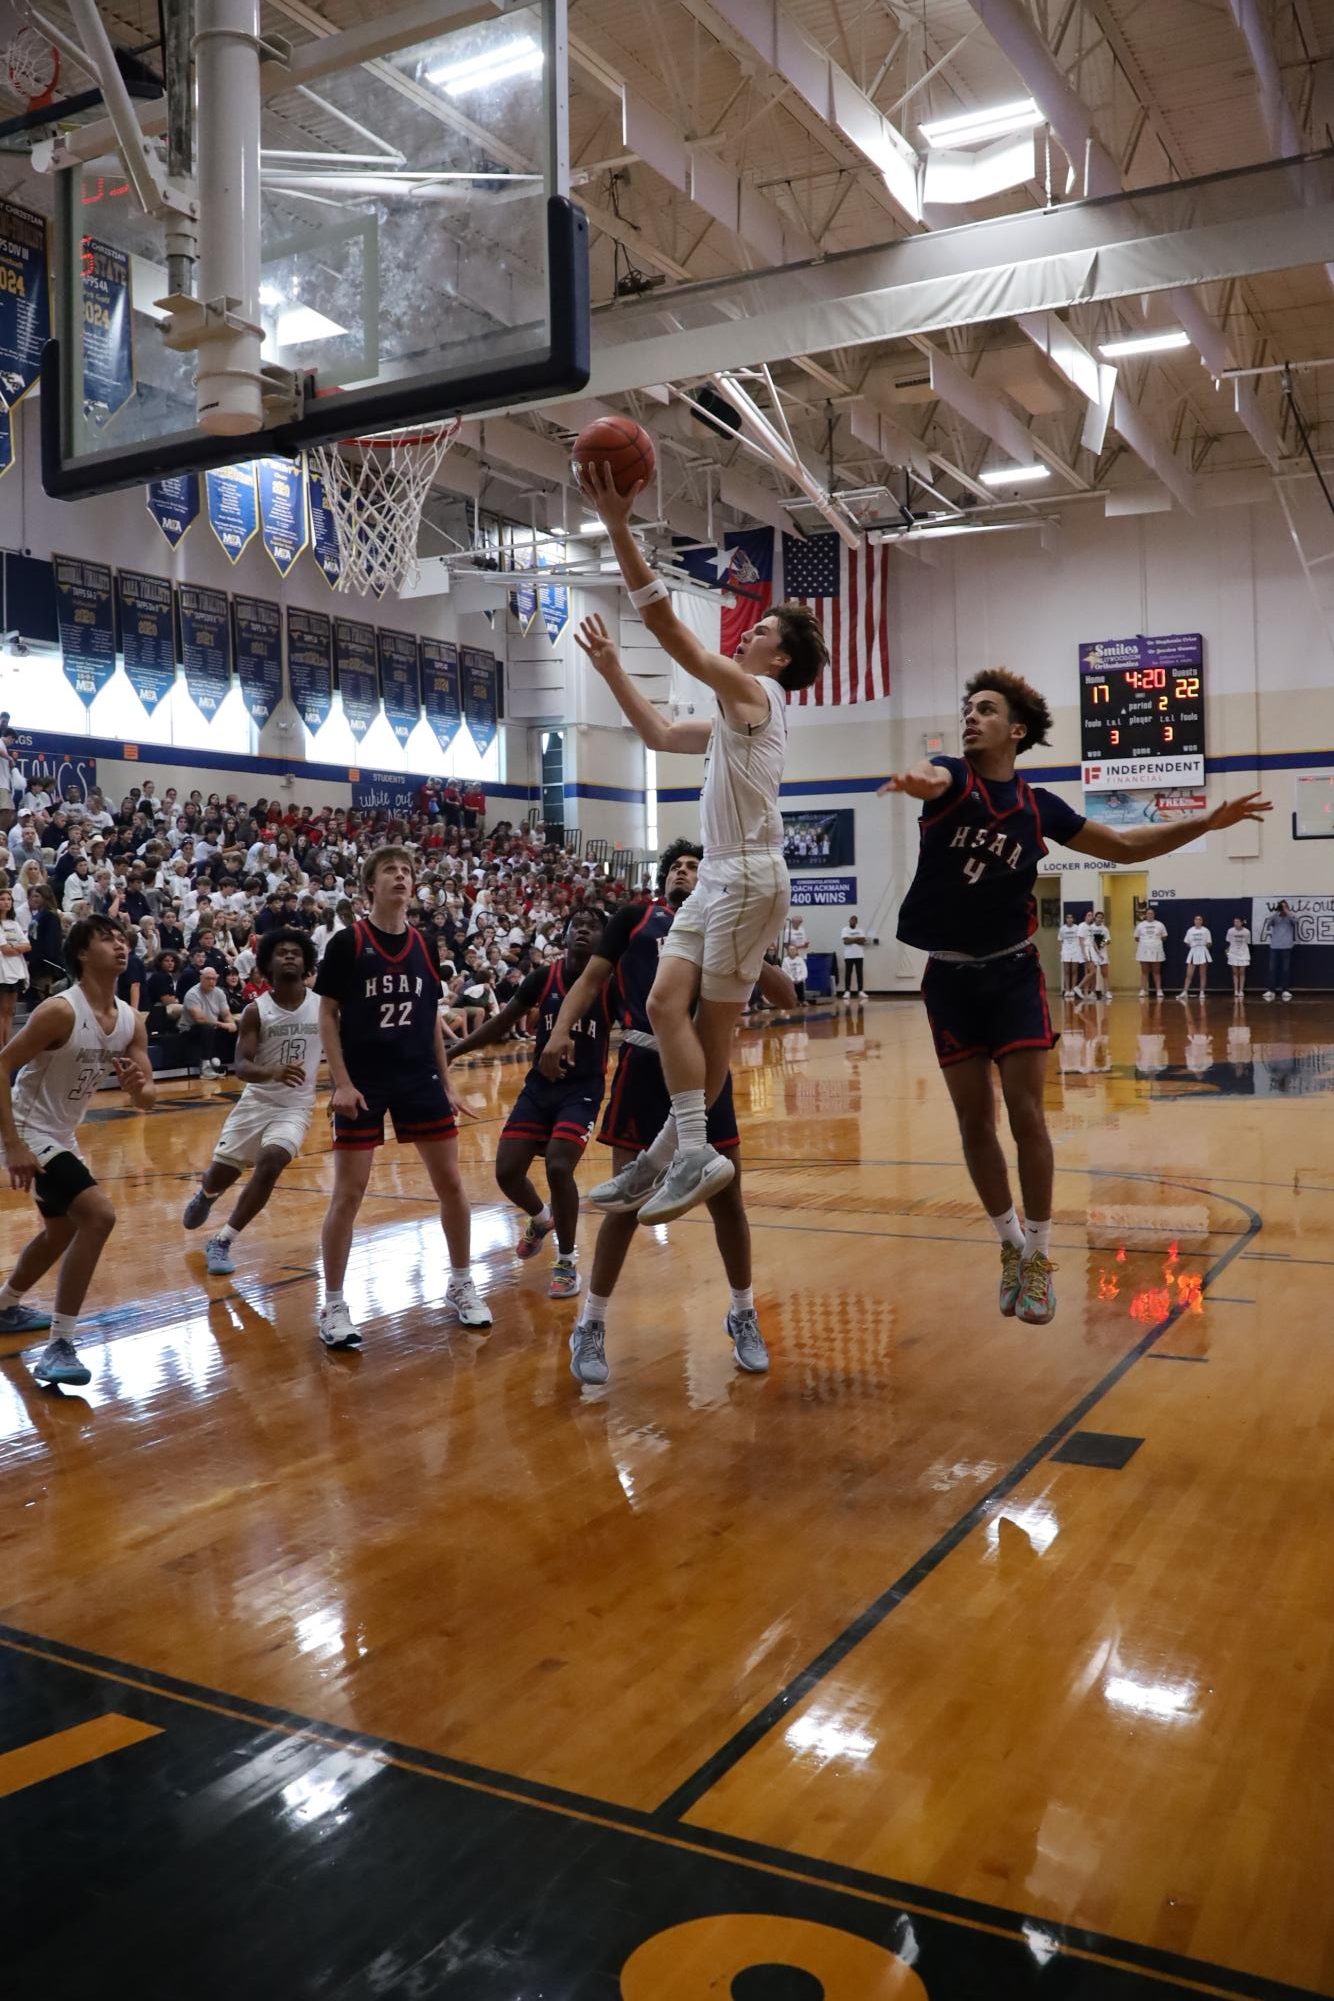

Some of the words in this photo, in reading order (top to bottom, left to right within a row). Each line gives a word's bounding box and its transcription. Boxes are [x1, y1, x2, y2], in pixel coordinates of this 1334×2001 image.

[1094, 643, 1139, 658] Smiles
[1085, 675, 1105, 684] Home
[1125, 669, 1166, 689] 4:20
[1172, 668, 1198, 678] Guests
[1093, 685, 1110, 704] 17
[1175, 678, 1200, 698] 22
[1128, 700, 1152, 712] period
[1158, 696, 1168, 711] 2
[1085, 719, 1102, 728] fouls
[1129, 715, 1153, 726] player
[1180, 712, 1198, 721] fouls
[1110, 730, 1120, 745] 3
[1164, 726, 1174, 742] 3
[1107, 761, 1200, 775] INDEPENDENT
[1107, 775, 1163, 784] FINANCIAL
[949, 825, 1024, 870] HSAA
[962, 857, 987, 885] 4
[1044, 863, 1080, 871] LOCKER
[1084, 861, 1117, 870] ROOMS
[791, 884, 813, 892] OACH
[814, 884, 850, 892] ACKMANN
[1152, 889, 1176, 898] BOYS
[792, 893, 812, 904] 400
[814, 892, 846, 903] WINS
[365, 974, 423, 999] HSAA
[380, 1001, 413, 1028] 22
[545, 1013, 597, 1040] HAA
[280, 1039, 306, 1066] 13
